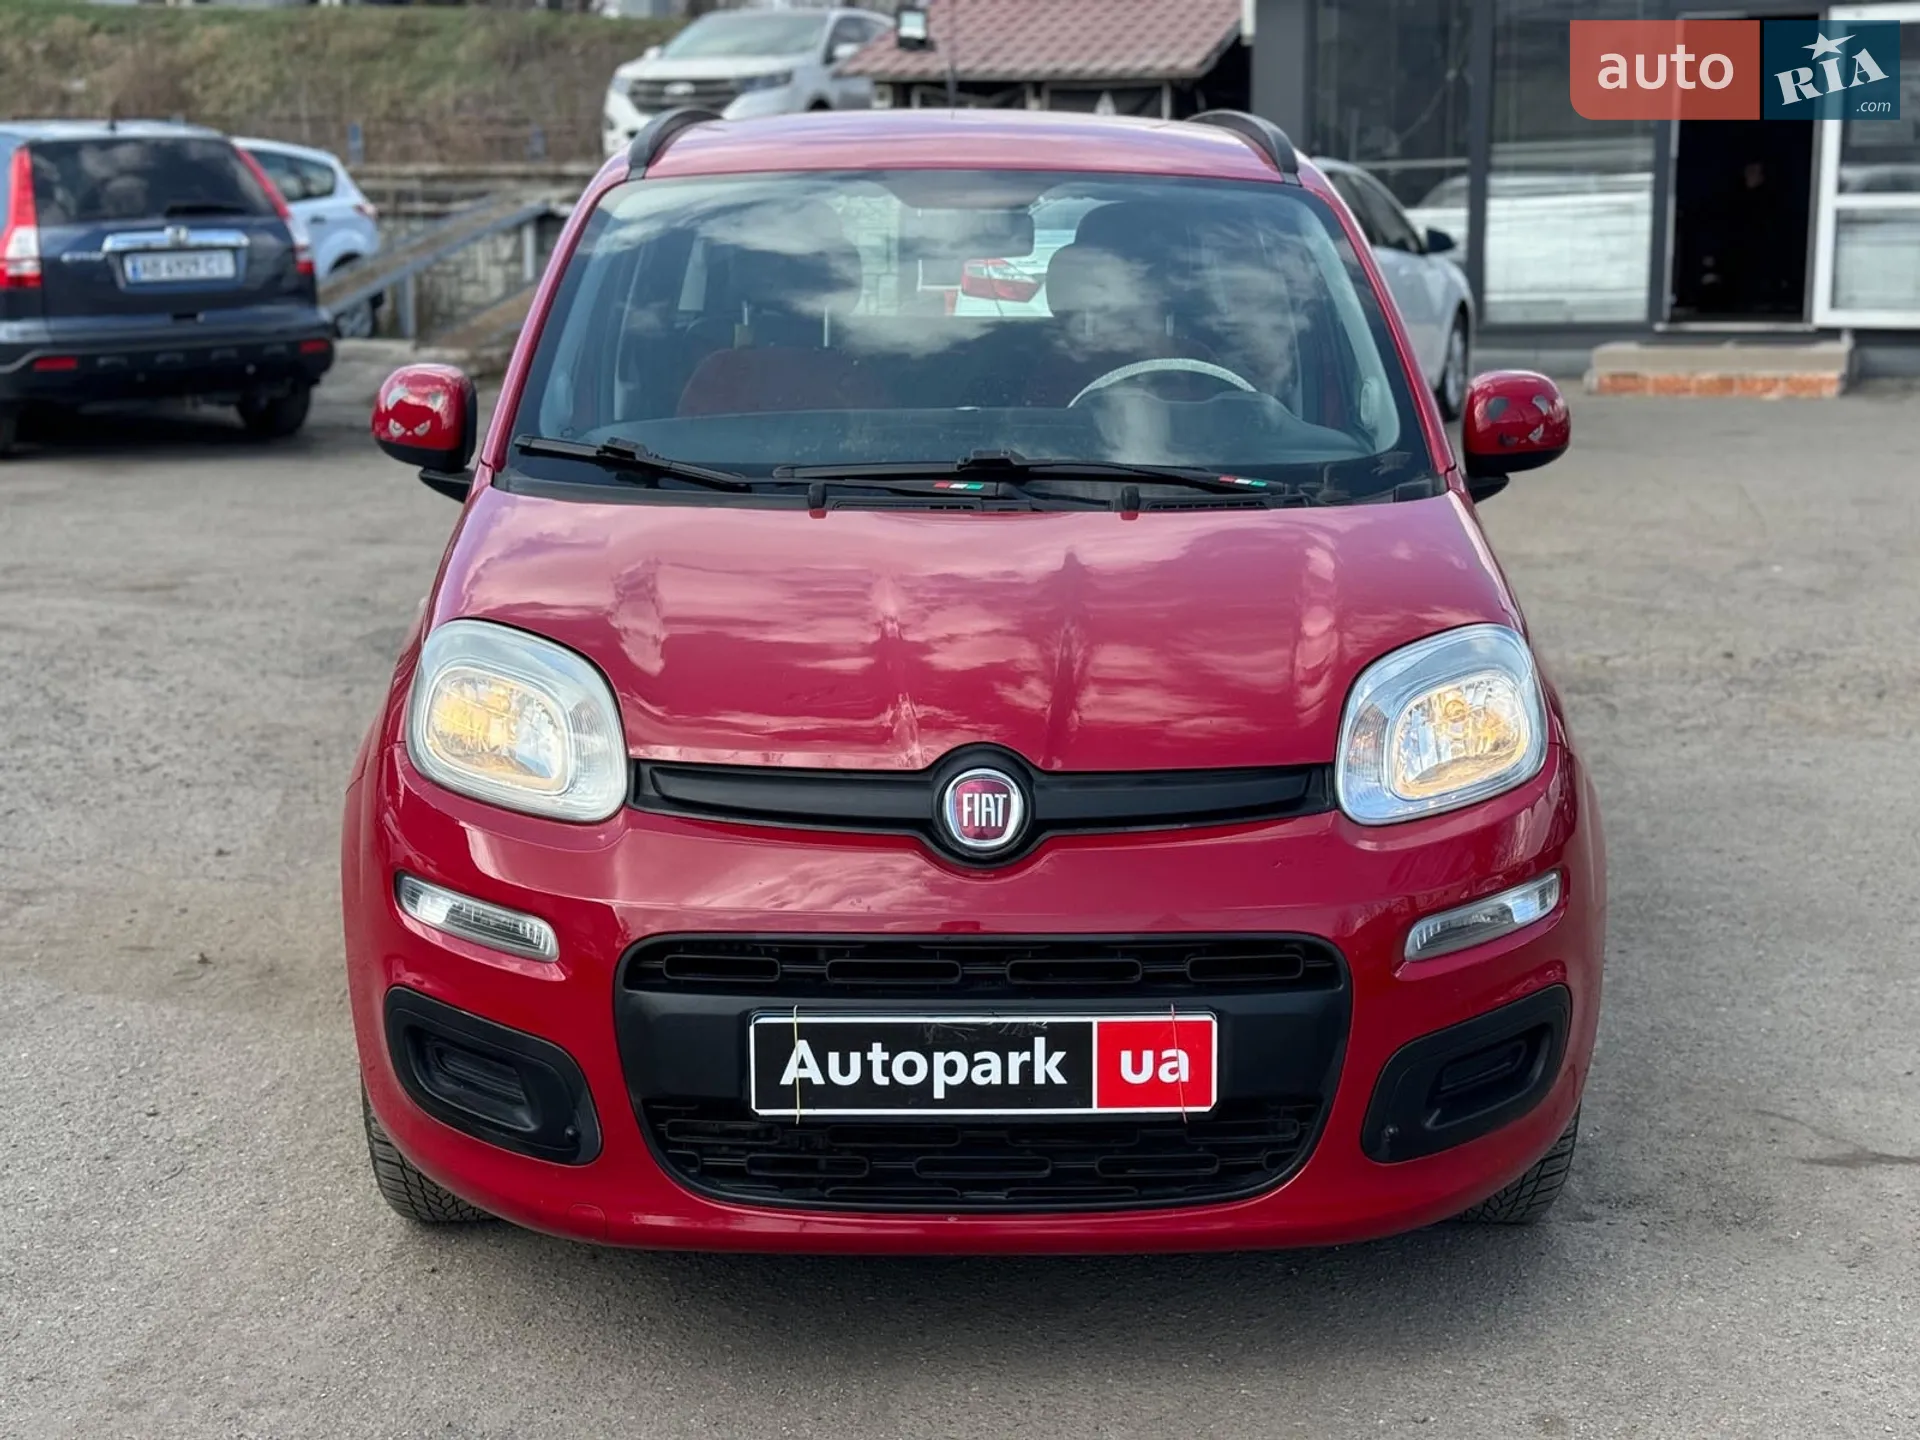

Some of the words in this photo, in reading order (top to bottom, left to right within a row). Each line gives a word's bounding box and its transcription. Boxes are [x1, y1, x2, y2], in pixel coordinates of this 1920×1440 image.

[962, 793, 1008, 827] FIAT
[779, 1037, 1068, 1099] Autopark
[1120, 1048, 1190, 1084] ua
